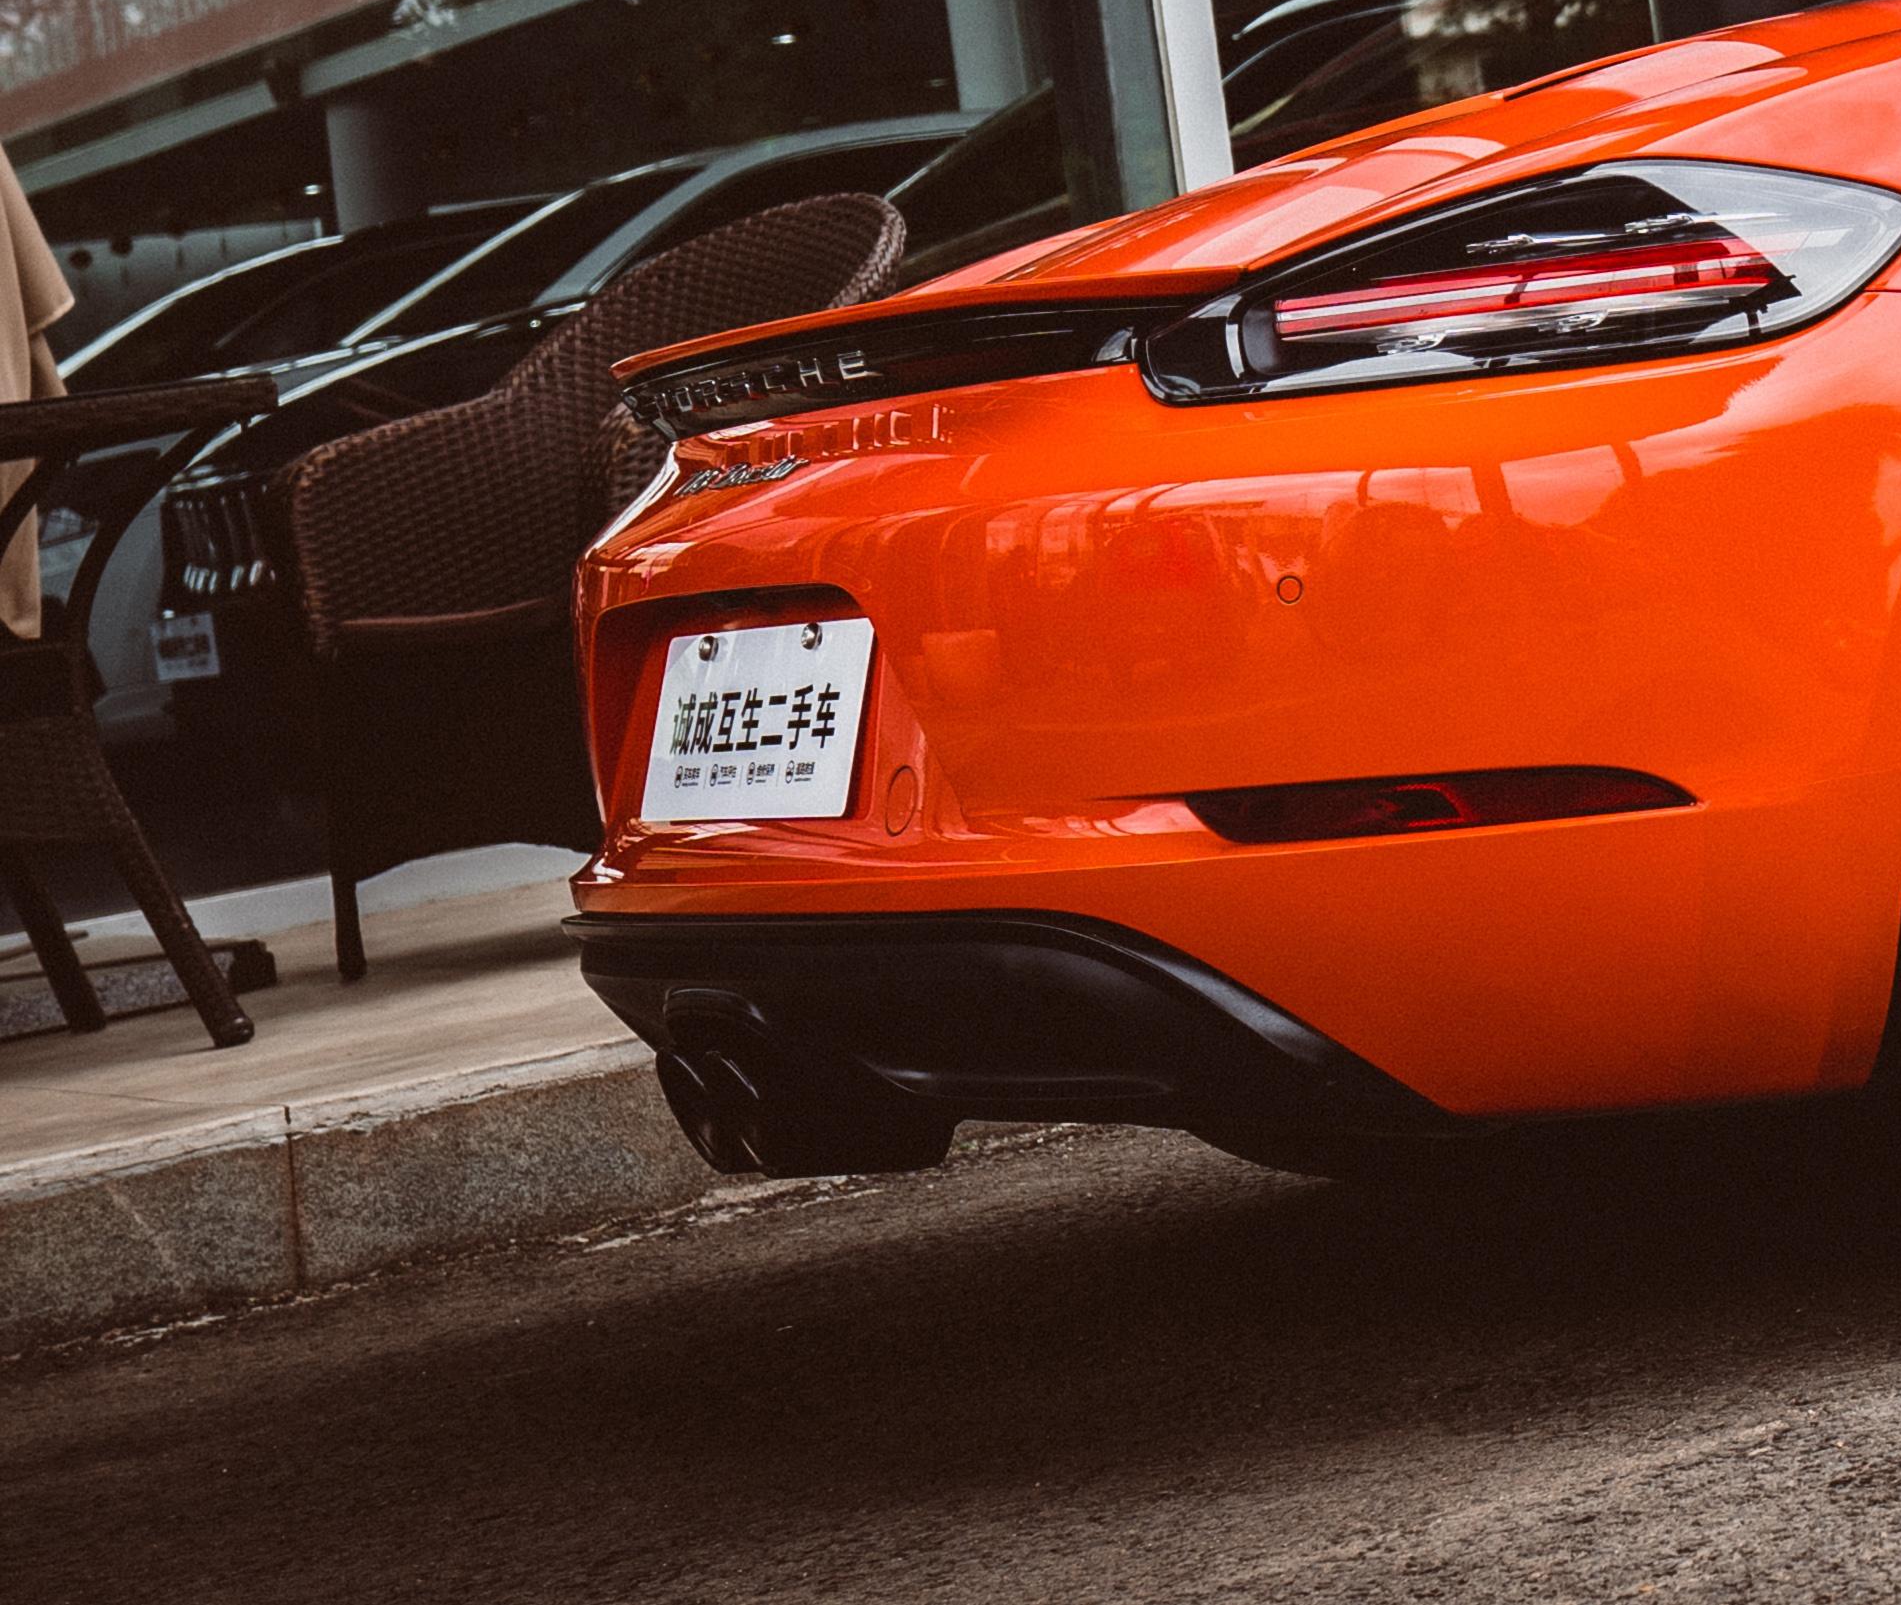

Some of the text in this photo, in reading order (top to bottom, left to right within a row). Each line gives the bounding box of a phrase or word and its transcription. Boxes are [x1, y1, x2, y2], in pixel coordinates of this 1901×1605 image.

[669, 682, 840, 756] 诚成互生二手车
